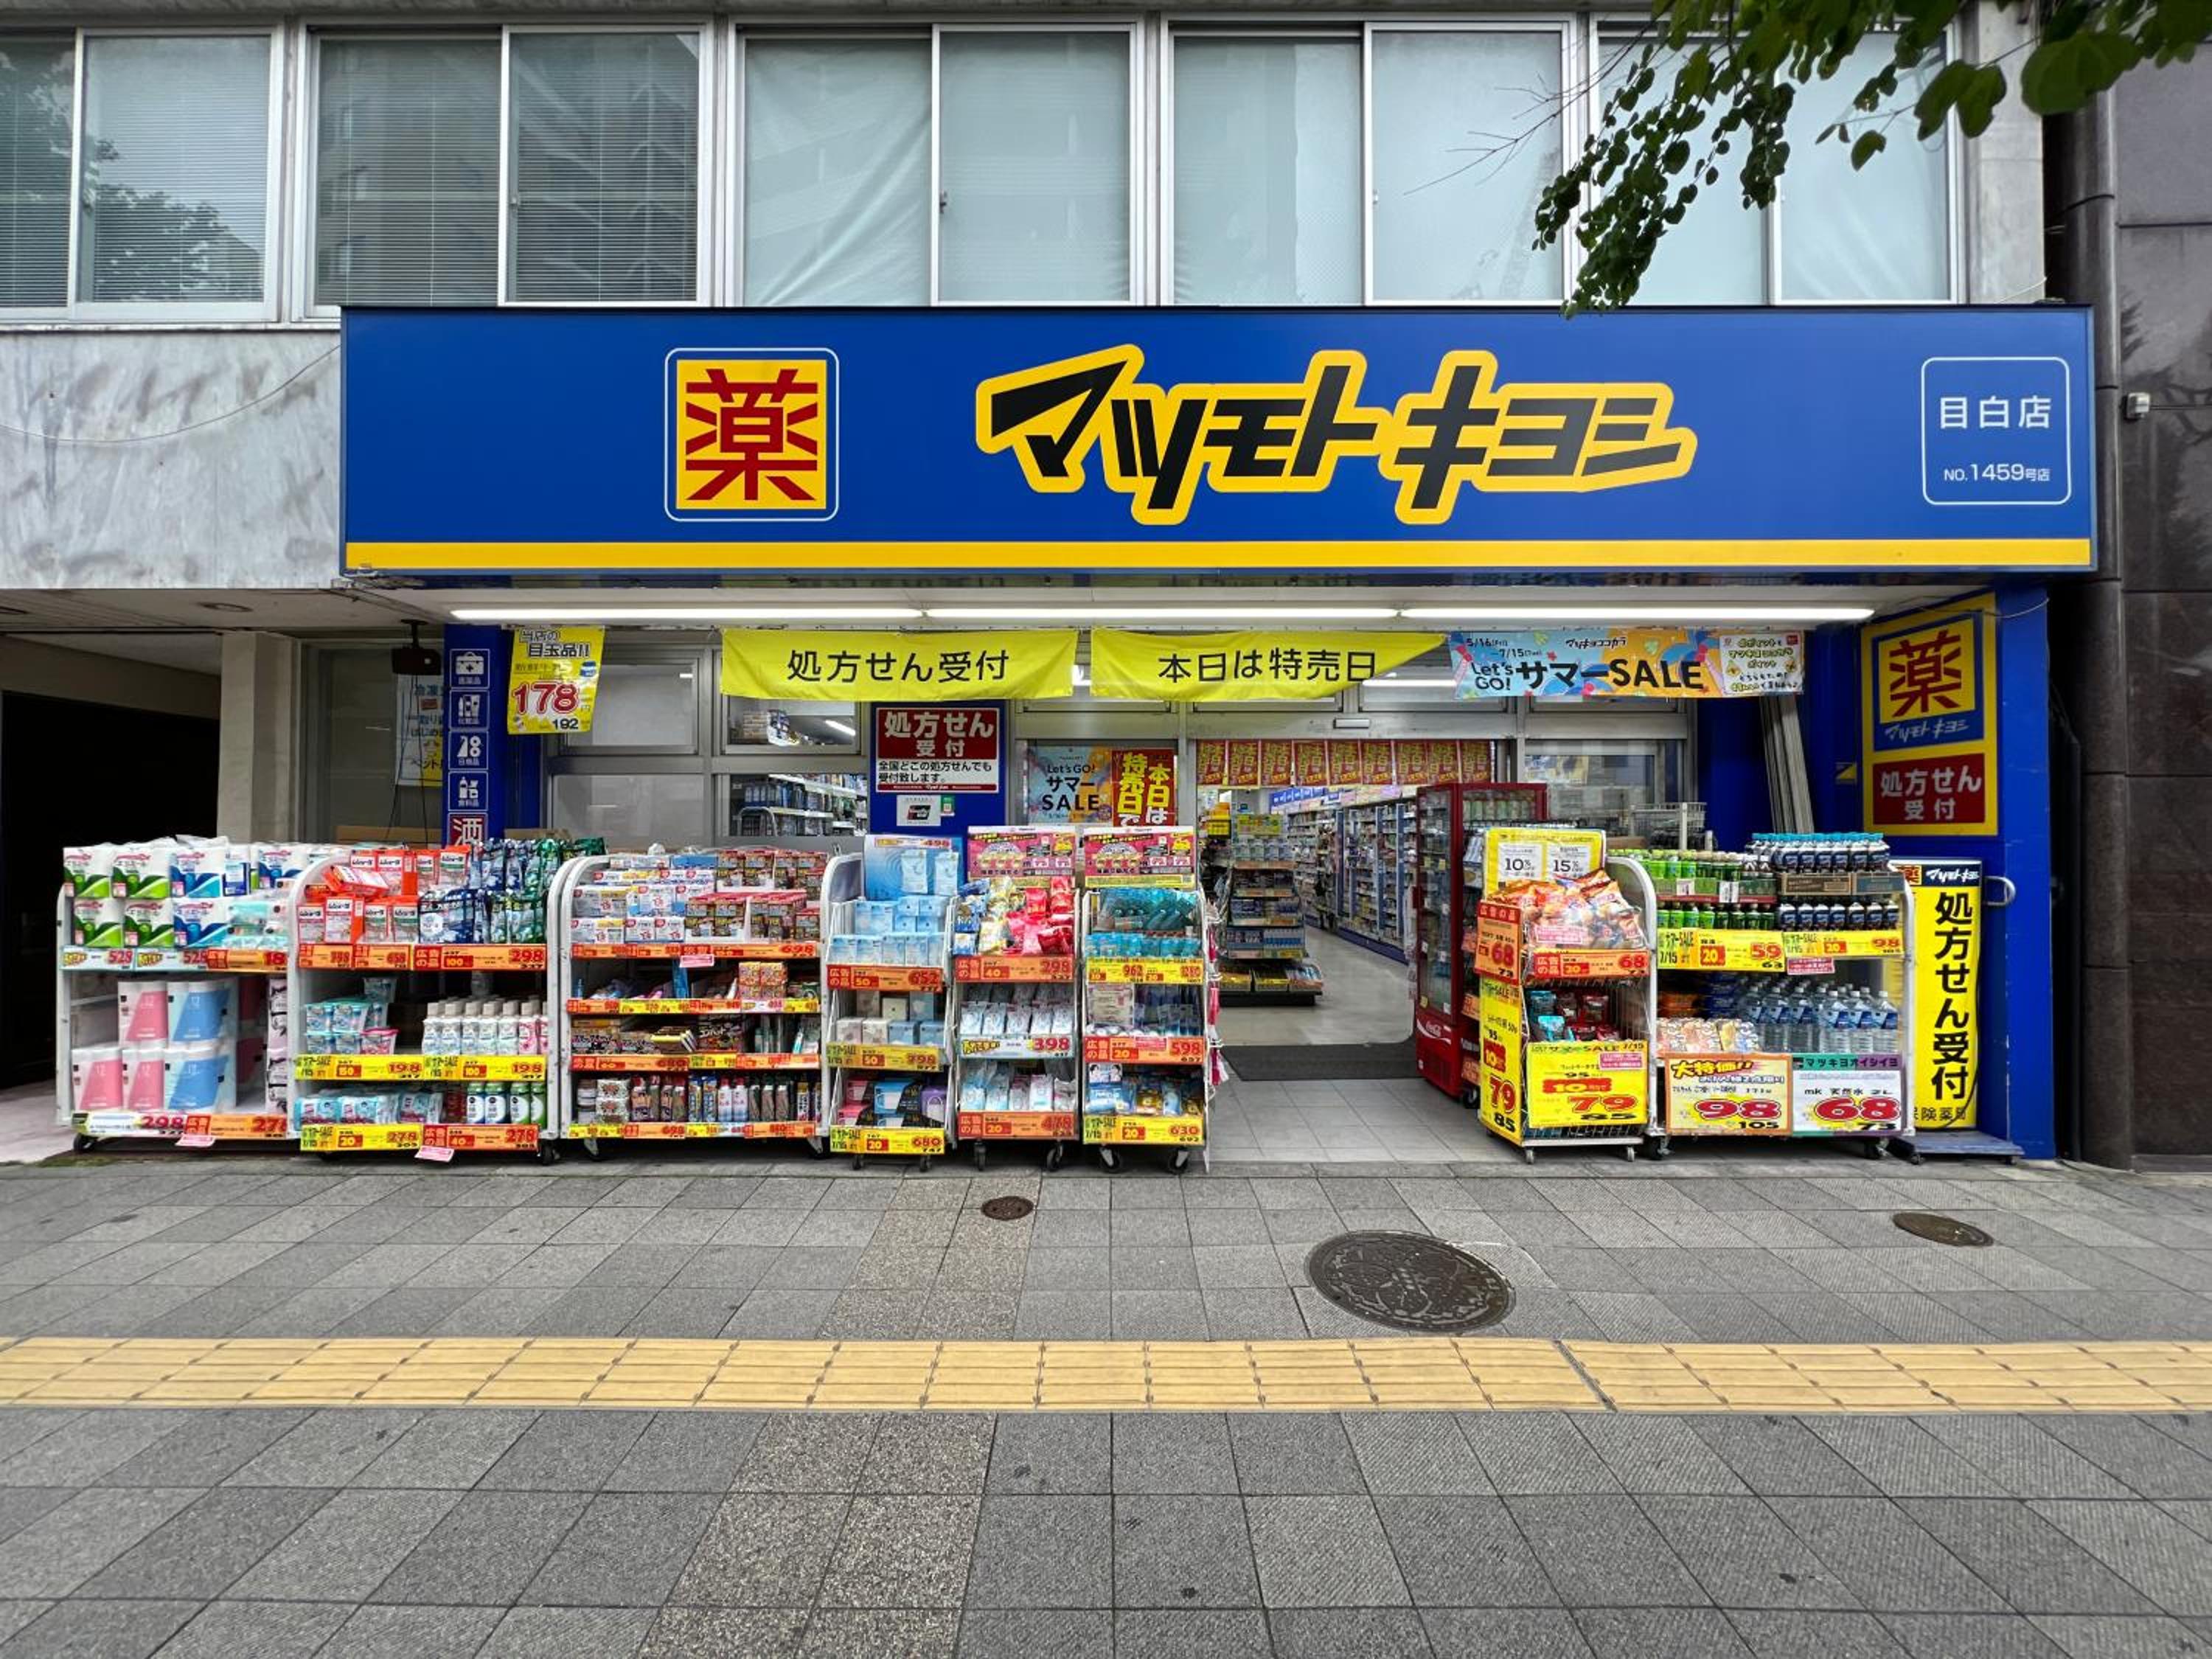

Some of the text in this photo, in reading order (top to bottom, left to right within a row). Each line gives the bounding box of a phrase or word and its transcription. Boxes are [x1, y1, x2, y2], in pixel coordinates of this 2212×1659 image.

[1939, 395, 2051, 429] 目白店
[685, 366, 819, 501] 薬
[988, 355, 1683, 512] マツモトキヨシ
[787, 650, 1009, 683] 処方せん受付
[1158, 649, 1377, 683] 本日は特売日
[1472, 661, 1513, 676] Let's
[1889, 629, 1962, 717] 薬
[1475, 677, 1511, 690] GO!
[513, 681, 579, 714] 178
[552, 718, 579, 729] 192
[884, 712, 994, 738] 処方せん
[1885, 717, 1969, 742] マツモトキヨシ
[917, 740, 964, 757] 受付
[879, 761, 992, 771] 全国どこの処方せんでも
[879, 773, 945, 782] 受付致します。
[1880, 765, 1982, 798] 処方せん
[1046, 777, 1094, 793] サマー
[1042, 794, 1099, 811] SALE
[1904, 799, 1956, 821] 受付
[779, 945, 815, 953] 698
[1826, 944, 1839, 953] 20
[1872, 939, 1902, 947] 98
[509, 949, 544, 963] 298
[1491, 942, 1514, 967] 68
[1702, 948, 1717, 961] 20
[1750, 943, 1783, 959] 59
[1618, 955, 1649, 968] 68
[985, 969, 1001, 977] 40
[855, 978, 871, 986] 50
[1931, 891, 1972, 1100] 処方せん受付
[1032, 1037, 1070, 1051] 398
[1087, 1040, 1107, 1049] 広告
[1170, 1042, 1200, 1055] 598
[1087, 1051, 1107, 1059] の品
[1114, 1050, 1130, 1058] 20
[388, 1064, 422, 1073] 198
[512, 1064, 543, 1074] 198
[1805, 1058, 1898, 1068] マツキヨオイシイヨ
[1489, 1075, 1516, 1113] 79
[1568, 1096, 1638, 1113] 79
[1695, 1099, 1781, 1119] 98
[1815, 1096, 1901, 1121] 68
[141, 1116, 184, 1129] 298
[1493, 1114, 1515, 1133] 85
[505, 1129, 538, 1143] 278
[868, 1141, 883, 1149] 20
